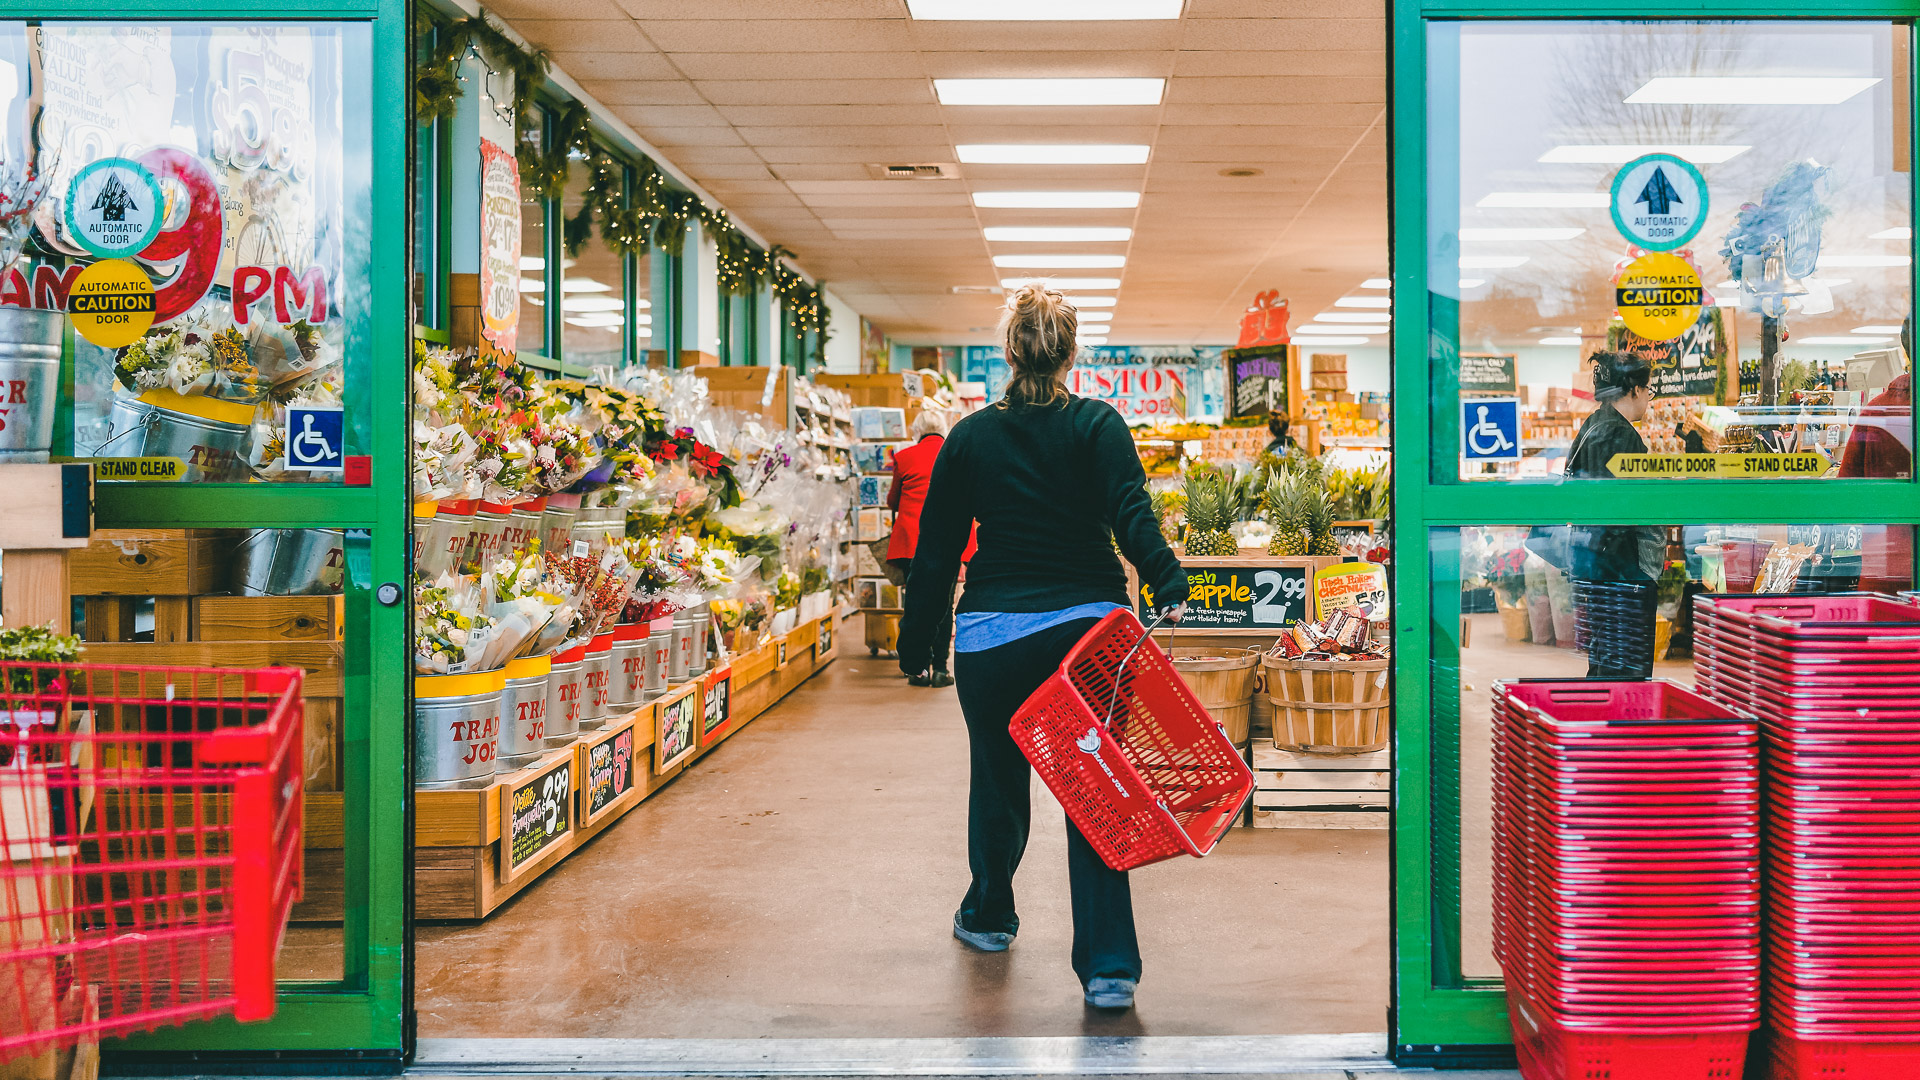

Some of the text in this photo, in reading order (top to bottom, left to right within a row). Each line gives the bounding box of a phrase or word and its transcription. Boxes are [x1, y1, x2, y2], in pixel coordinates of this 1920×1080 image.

[35, 28, 87, 65] enormous
[36, 49, 87, 86] VALUE
[1634, 216, 1688, 227] AUTOMATIC
[89, 223, 142, 233] AUTOMATIC
[1648, 228, 1675, 238] DOOR
[103, 234, 129, 244] DOOR
[1626, 275, 1694, 285] AUTOMATIC
[79, 281, 146, 292] AUTOMATIC
[231, 265, 328, 325] PM
[1622, 289, 1699, 304] CAUTION
[75, 296, 150, 311] CAUTION
[1644, 308, 1677, 317] DOOR
[96, 315, 129, 324] DOOR
[101, 461, 137, 476] STAND
[140, 461, 176, 476] CLEAR
[1619, 457, 1818, 473] AUTOMATIC DOOR STAND CLEAR
[1320, 576, 1343, 588] Fresh
[1196, 606, 1215, 615] fresh
[1216, 608, 1247, 617] pineapple
[1224, 614, 1242, 624] ham!
[541, 767, 569, 836] $3.99
